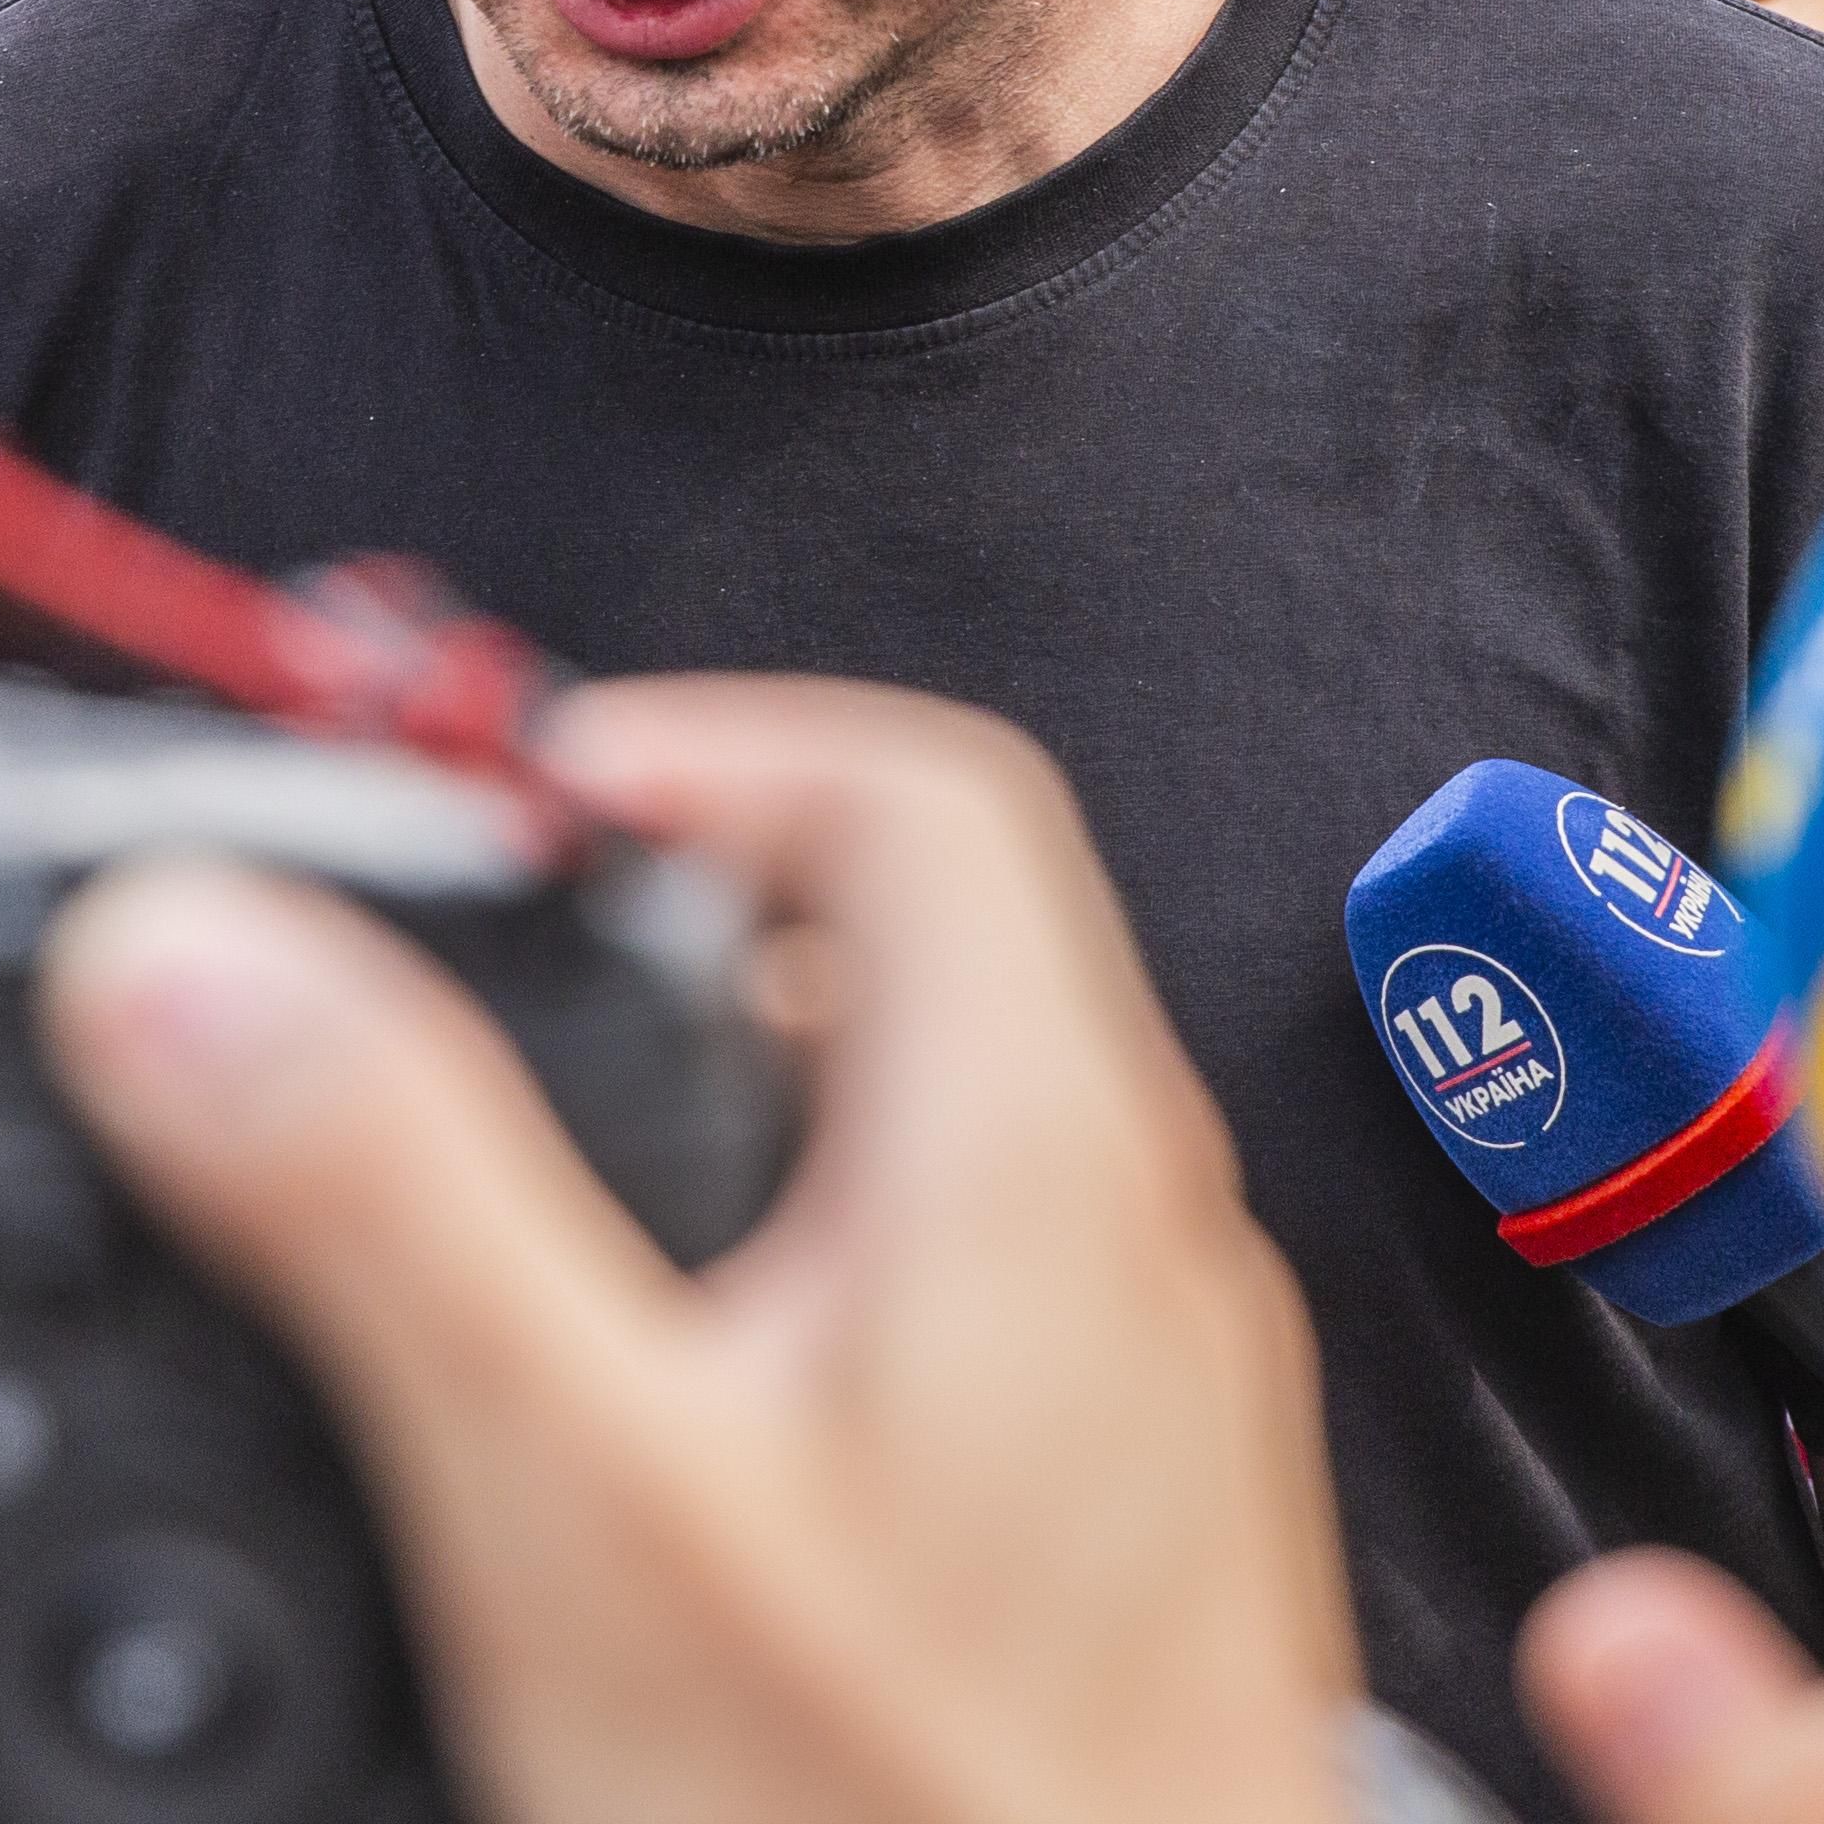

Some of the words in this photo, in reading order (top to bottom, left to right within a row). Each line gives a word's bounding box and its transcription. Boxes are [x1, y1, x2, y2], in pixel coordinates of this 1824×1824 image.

[1589, 809, 1672, 905] 112
[1393, 974, 1525, 1079] 112
[1444, 1058, 1555, 1124] УКРАЇНА
